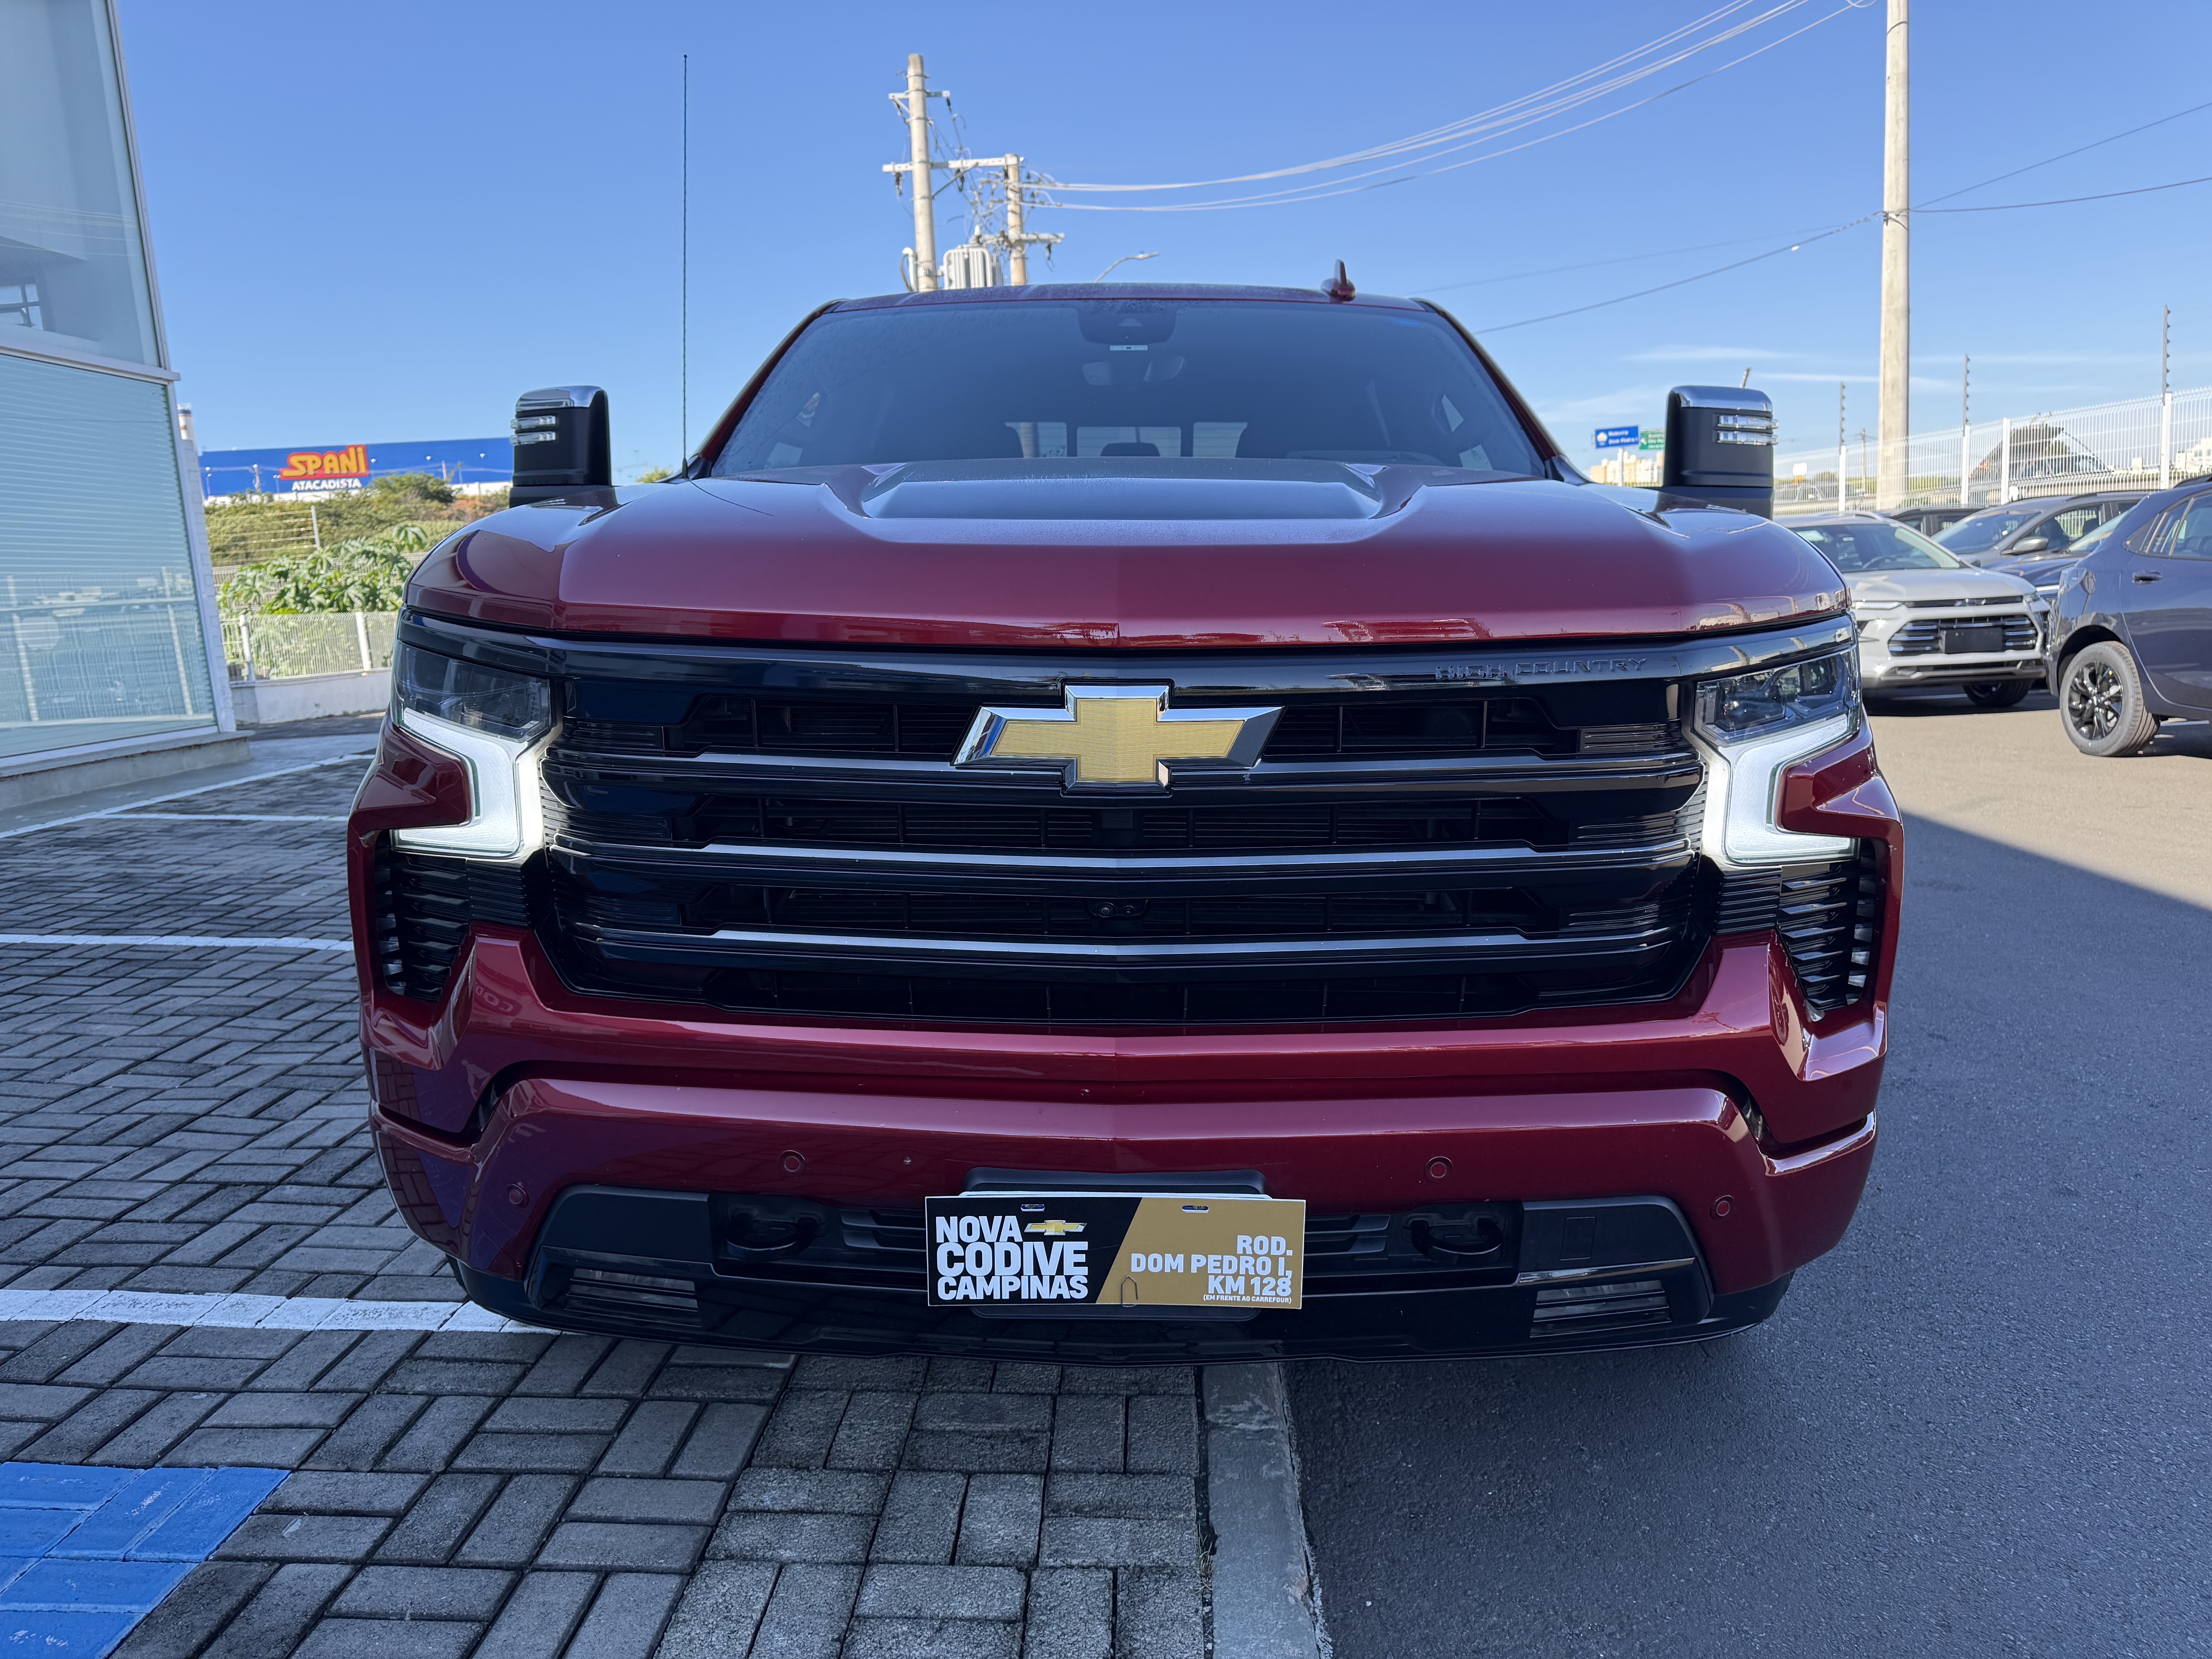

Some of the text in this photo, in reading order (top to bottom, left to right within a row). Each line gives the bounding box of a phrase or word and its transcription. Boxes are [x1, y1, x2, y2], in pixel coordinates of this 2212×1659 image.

[292, 478, 362, 491] ATACADISTA
[1435, 658, 1646, 680] HIGH COUNTRY
[936, 1216, 1023, 1243] NOVA
[1237, 1235, 1293, 1256] ROD.
[937, 1242, 1088, 1277] CODIVE
[1131, 1253, 1292, 1279] DOM PEDRO I,
[938, 1275, 1088, 1300] CAMPINAS
[1208, 1275, 1291, 1297] KM 128
[1251, 1296, 1292, 1304] CARREFOUR)
